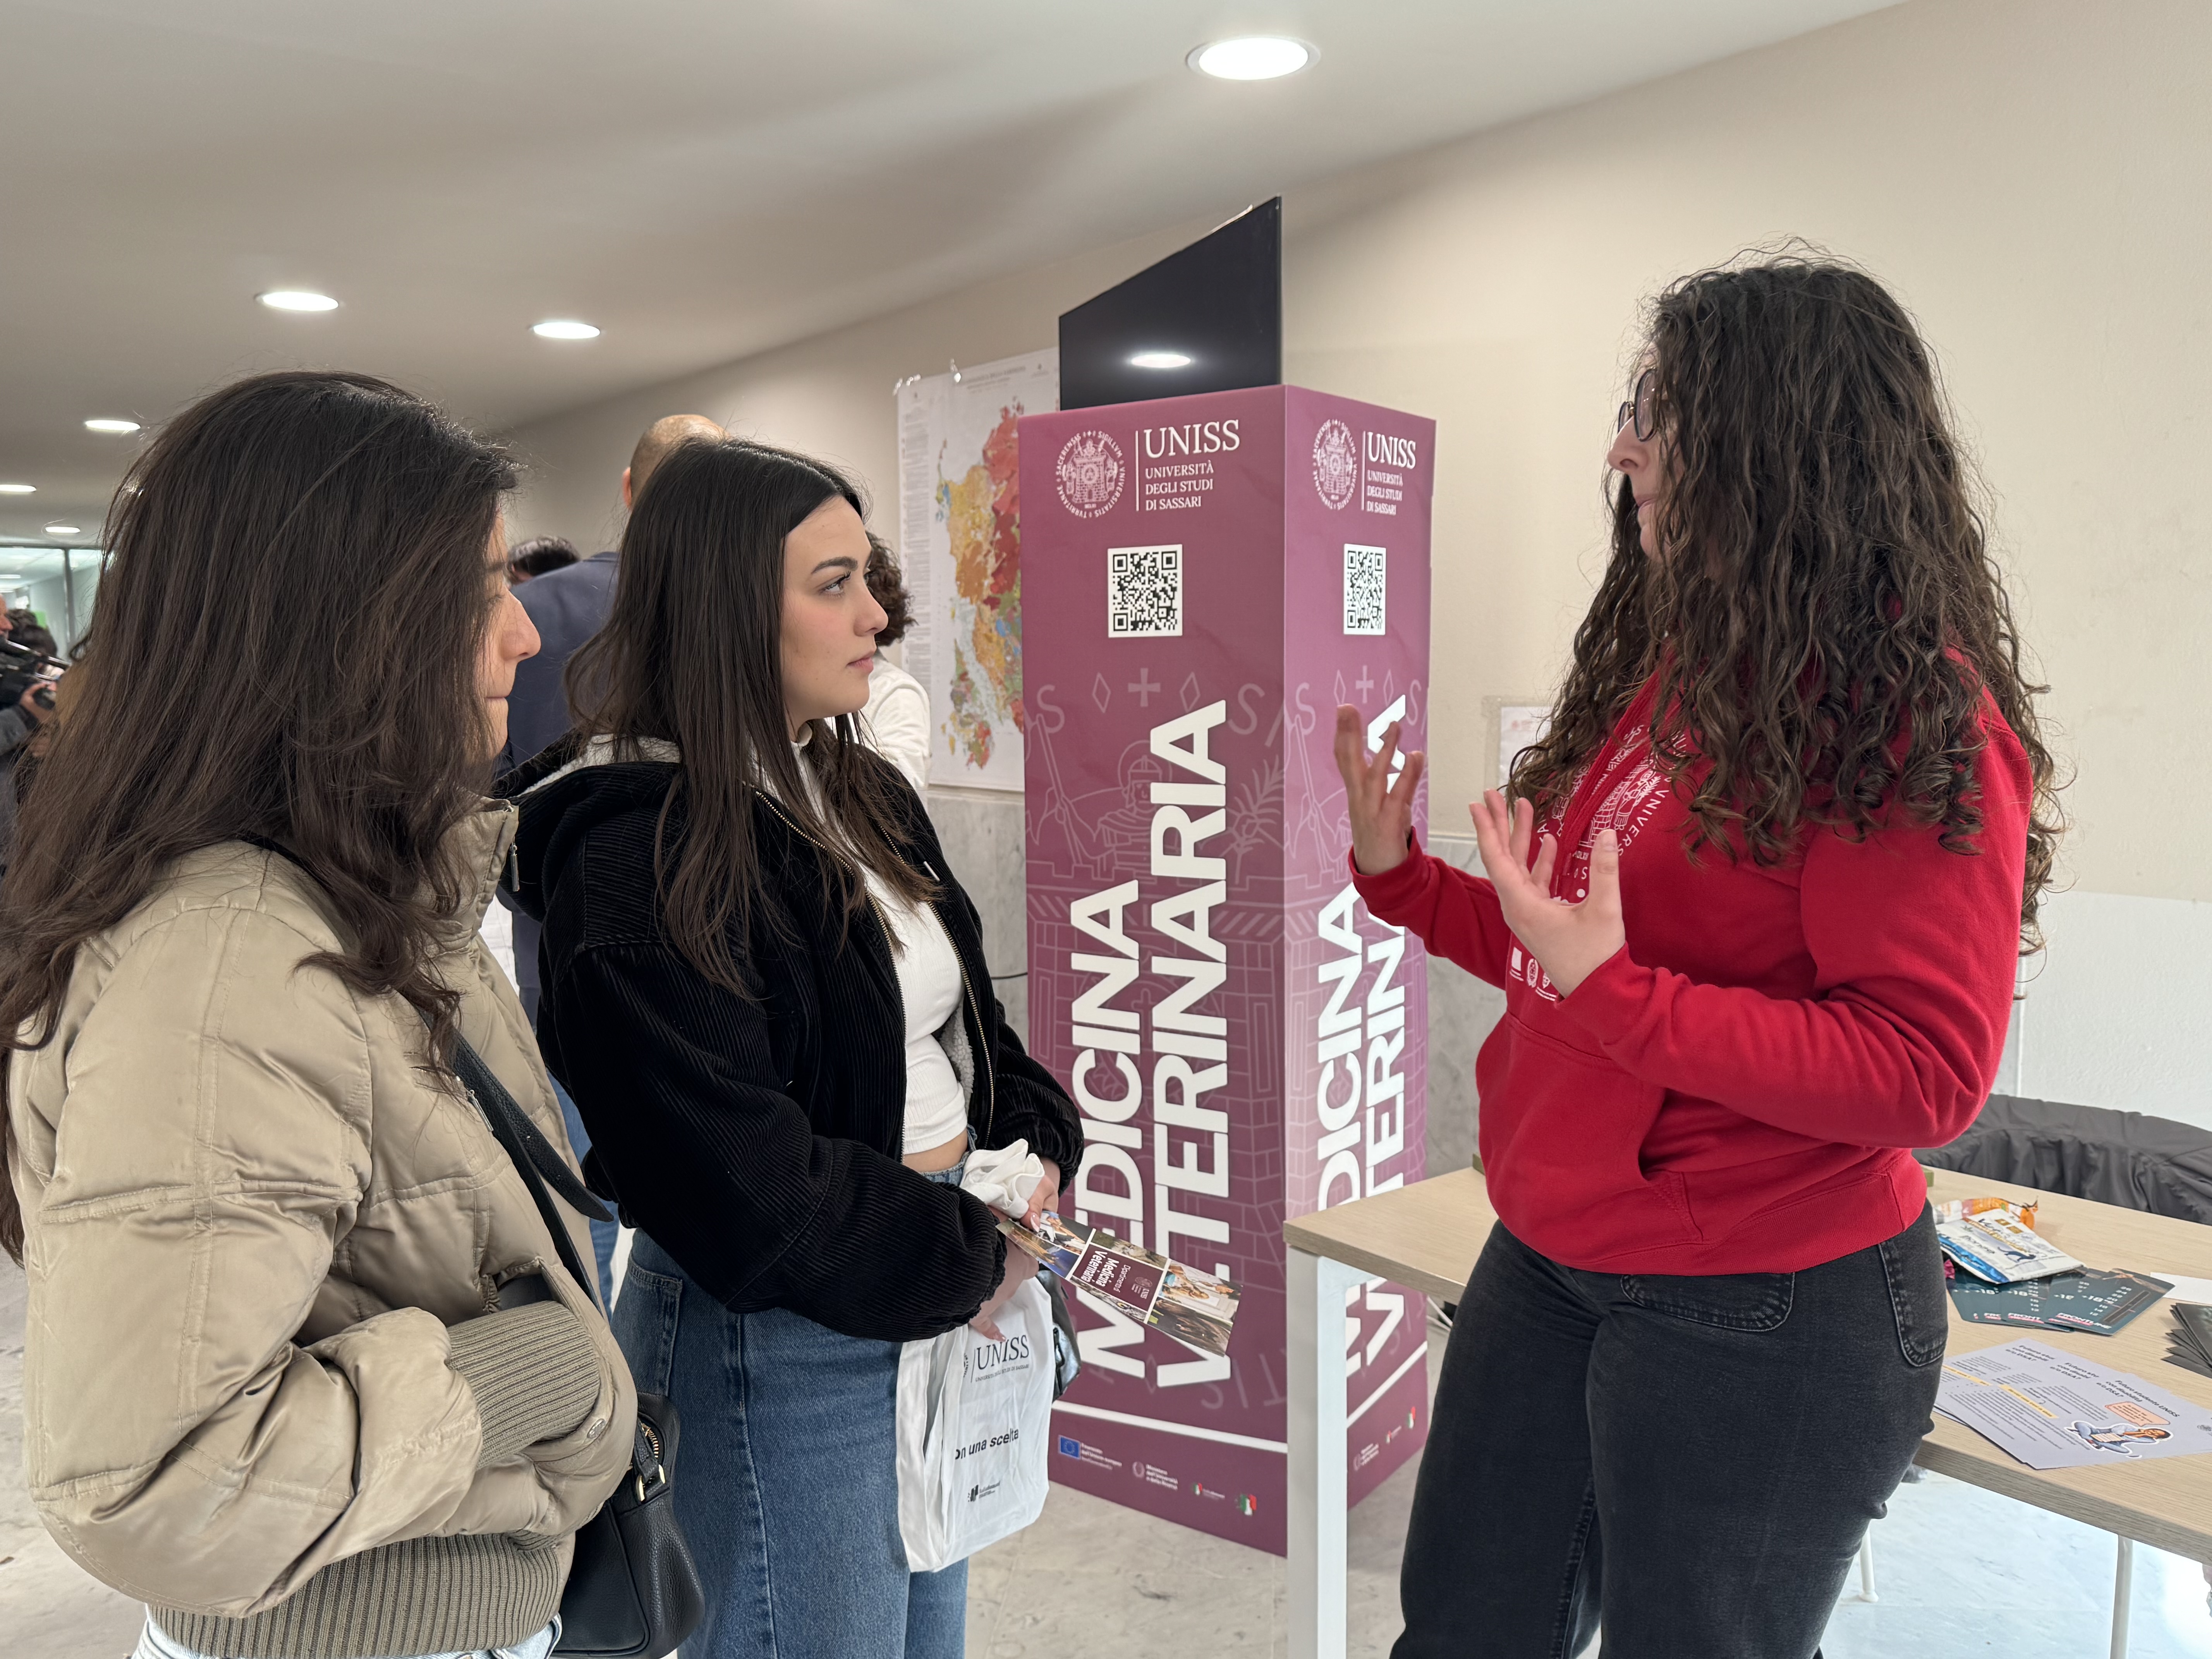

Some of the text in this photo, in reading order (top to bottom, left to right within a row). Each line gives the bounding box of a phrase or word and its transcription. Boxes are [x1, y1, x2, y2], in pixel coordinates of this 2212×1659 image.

[1144, 419, 1240, 458] UNISS
[1367, 431, 1416, 469] UNISS
[1145, 460, 1214, 479] UNIVERSITÀ
[1367, 469, 1403, 487] UNIVERSITÀ
[1145, 479, 1214, 496] DEGLI STUDI
[1367, 485, 1403, 501] DEGLI STUDI
[1146, 496, 1202, 511] DI SASSARI
[1367, 501, 1396, 516] DI SASSARI
[1150, 699, 1231, 1388] VTERINARIA
[1096, 1257, 1120, 1287] Medicina
[2057, 1312, 2112, 1329] FRONTLINE
[977, 1334, 1030, 1370] UNISS
[2115, 1380, 2135, 1392] Futuro
[2133, 1391, 2160, 1406] studente
[2158, 1405, 2180, 1417] UNISS
[969, 1439, 987, 1455] una
[989, 1428, 1019, 1447] scelta
